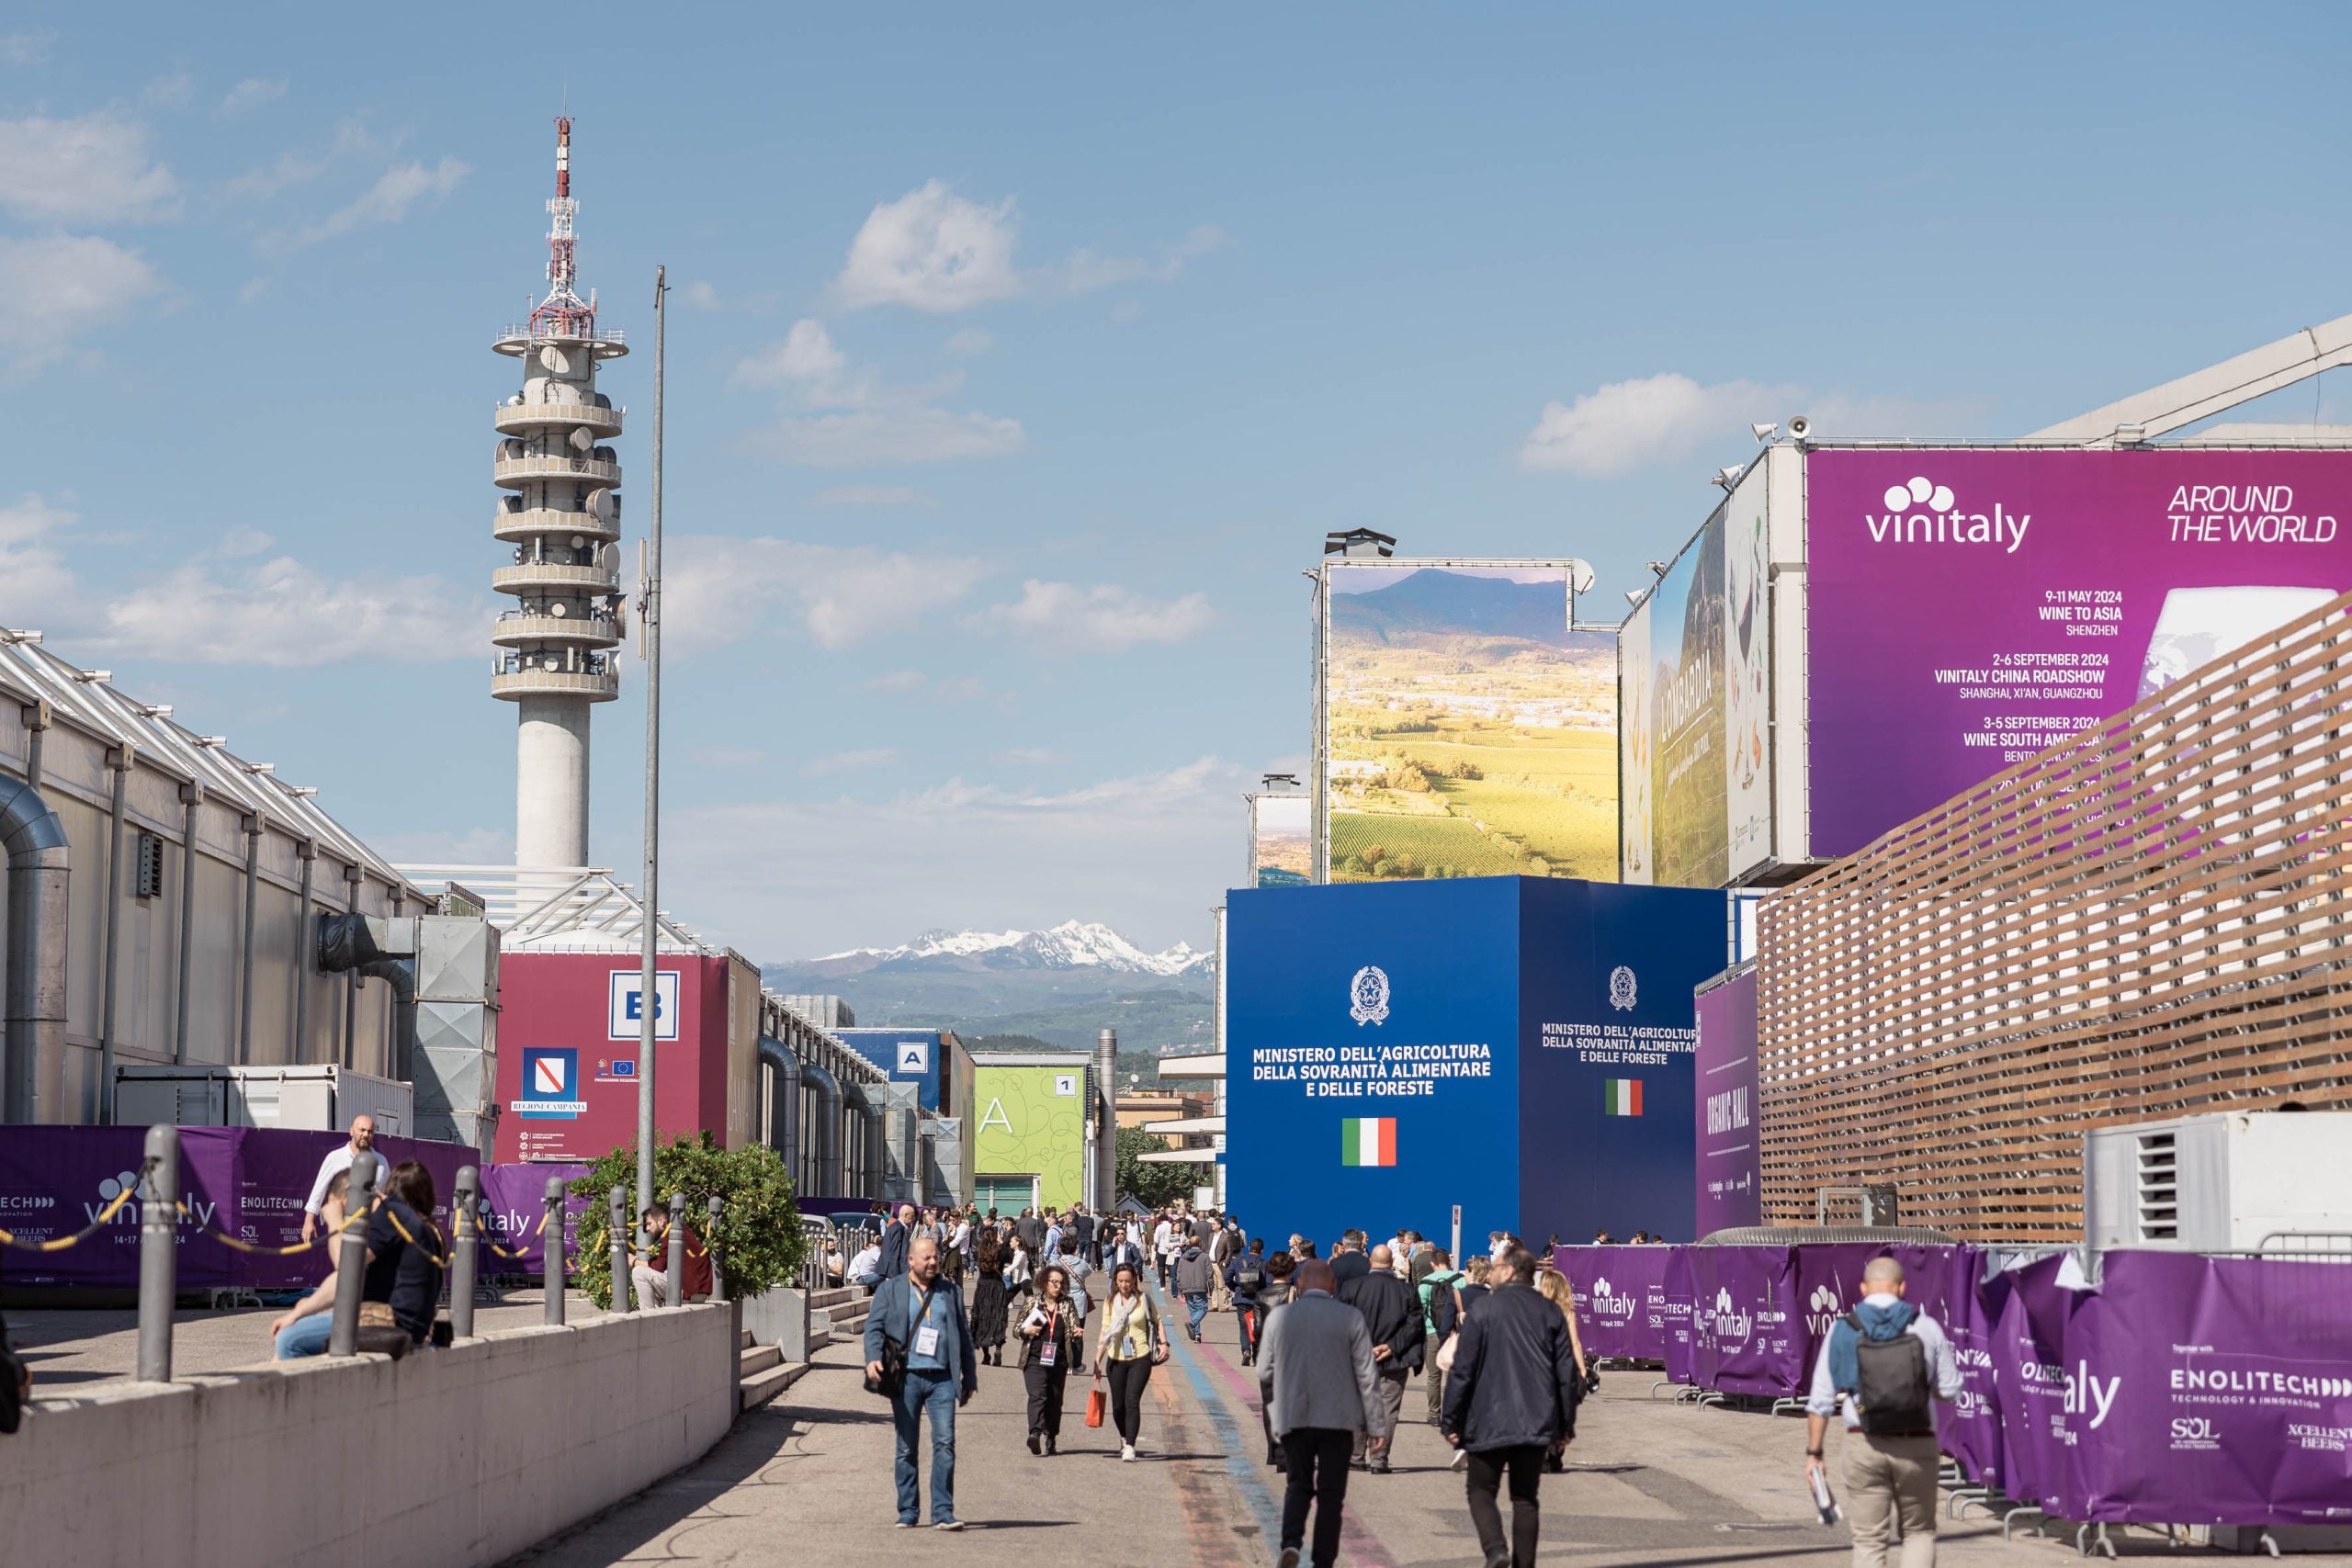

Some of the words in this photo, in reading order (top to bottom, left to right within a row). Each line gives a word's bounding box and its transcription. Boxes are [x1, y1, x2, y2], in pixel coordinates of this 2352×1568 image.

[2167, 485, 2293, 513] AROUND
[1865, 502, 2031, 554] vinitaly
[2167, 515, 2224, 542] THE
[2228, 515, 2337, 543] WORLD
[2045, 591, 2066, 603] 9-11
[2068, 591, 2093, 603] MAY
[2095, 591, 2122, 603] 2024
[2039, 607, 2072, 620] WINE
[2075, 607, 2091, 620] TO
[2093, 607, 2122, 620] ASIA
[2066, 625, 2118, 636] SHENZHEN
[1993, 653, 2012, 666] 2-6
[2013, 653, 2078, 666] SEPTEMBER
[2081, 653, 2109, 666] 2024
[1935, 670, 1988, 683] VINITALY
[1991, 670, 2030, 683] CHINA
[2032, 670, 2105, 683] ROADSHOW
[1661, 649, 1712, 743] LOMBARDIA
[1960, 688, 2012, 700] SHANGHAI,
[2042, 688, 2103, 699] GUANGZHOU
[1984, 717, 2003, 729] 3-5
[2005, 716, 2070, 729] SEPTEMBER
[2072, 716, 2100, 729] 2024
[1963, 733, 1997, 747] WINE
[1999, 733, 2041, 747] SOUTH
[1542, 1022, 1600, 1036] MINISTERO
[1603, 1026, 1696, 1040] DELL'AGRICOLTUR
[1543, 1036, 1574, 1048] DELLA
[1576, 1035, 1635, 1051] SOVRANITÀ
[1639, 1040, 1696, 1053] ALIMENTAR
[904, 1051, 921, 1064] A
[1253, 1047, 1336, 1063] MINISTERO
[1340, 1044, 1491, 1062] DELL'AGRICOLTURA
[1580, 1051, 1587, 1062] E
[1589, 1051, 1620, 1063] DELLE
[1623, 1053, 1668, 1065] FORESTE
[1253, 1066, 1296, 1080] DELLA
[1300, 1060, 1386, 1079] SOVRANITÀ
[1391, 1062, 1491, 1077] ALIMENTARE
[1061, 1080, 1069, 1090] 1
[1306, 1082, 1315, 1097] E
[1318, 1082, 1363, 1097] DELLE
[1367, 1080, 1433, 1096] FORESTE
[513, 1102, 545, 1111] REGIONE
[1707, 1090, 1732, 1135] ORGANIC
[1733, 1085, 1749, 1128] HALL
[978, 1097, 1013, 1134] A
[114, 1235, 137, 1244] 14-17
[1592, 1292, 1635, 1320] vinitaly
[2173, 1344, 2198, 1354] Together
[2199, 1344, 2214, 1353] with
[2171, 1394, 2245, 1404] TECHNOLOGY
[2248, 1396, 2256, 1404] &
[2259, 1396, 2321, 1409] INNOVATION
[2301, 1437, 2346, 1452] BEERS
